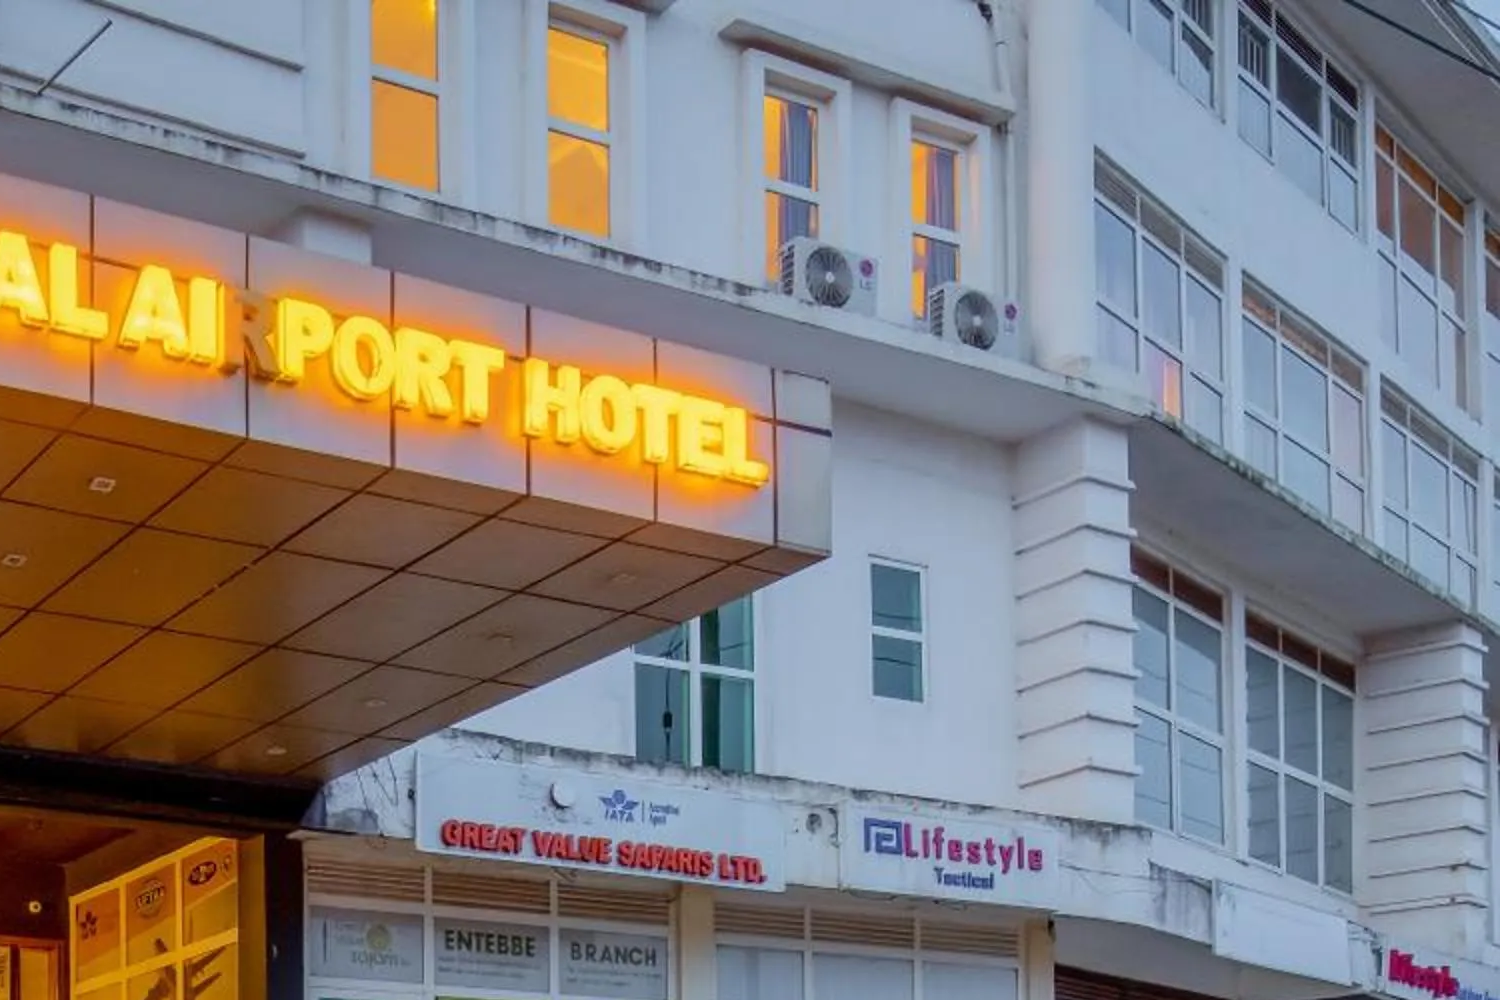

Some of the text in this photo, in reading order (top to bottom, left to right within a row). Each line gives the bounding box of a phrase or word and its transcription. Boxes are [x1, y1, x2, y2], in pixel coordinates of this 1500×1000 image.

[116, 263, 505, 425] AIRPORT
[522, 358, 770, 488] HOTEL
[604, 807, 635, 823] IATA
[440, 818, 527, 855] GREAT
[532, 830, 612, 865] VALUE
[617, 840, 714, 877] SAFARIS
[903, 822, 1043, 875] Lifestyle
[933, 866, 995, 890] Tactical
[444, 929, 536, 958] ENTEBBE
[570, 941, 657, 967] BRANCH
